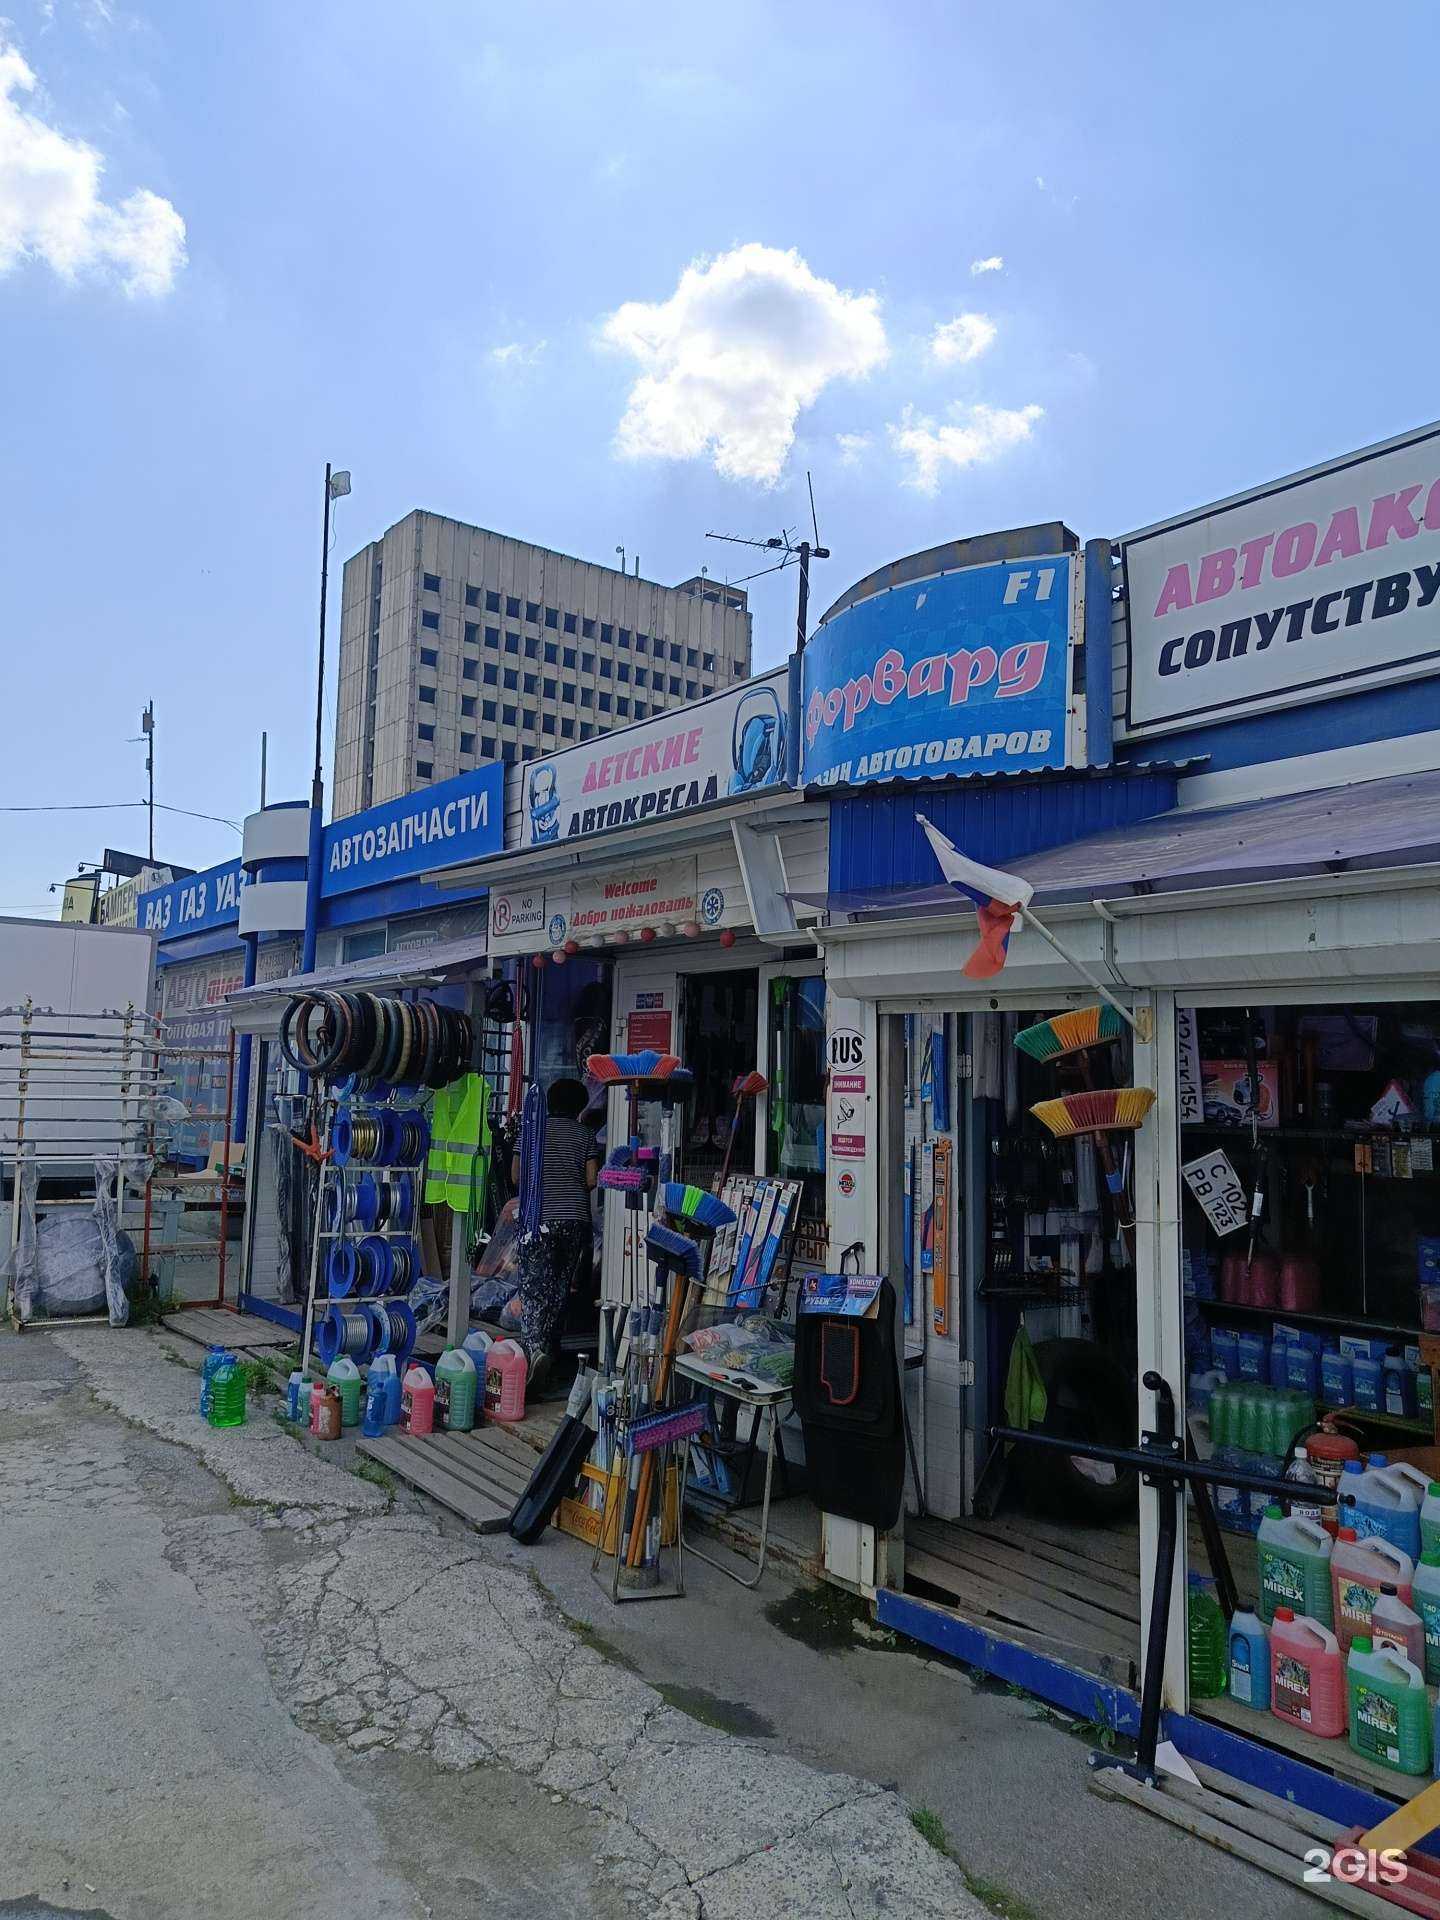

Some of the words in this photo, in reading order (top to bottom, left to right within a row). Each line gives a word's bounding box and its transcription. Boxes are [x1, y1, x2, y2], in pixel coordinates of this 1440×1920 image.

[1003, 568, 1056, 605] F1
[1158, 562, 1440, 677] СОПУТСТВУ
[581, 727, 703, 795] ДЕТСКИЕ
[855, 729, 1051, 778] АВТОТОВАРОВ
[567, 775, 718, 837] АВТОКРЕСЛА
[329, 791, 489, 873] АВТОЗАПЧАСТИ
[144, 894, 172, 930] ВАЗ
[178, 882, 208, 924] ГАЗ
[215, 868, 247, 912] УАЗ
[521, 897, 533, 910] NO
[603, 878, 658, 899] Welcome
[511, 910, 543, 925] PARKING
[572, 910, 607, 928] Добро
[610, 896, 694, 920] пожаловать
[1212, 1202, 1234, 1227] 123
[1221, 1182, 1248, 1215] 102
[1263, 1578, 1305, 1602] MIREX
[1341, 1606, 1373, 1625] MIRE
[1275, 1674, 1310, 1697] MIREX
[1357, 1710, 1398, 1736] MIREX
